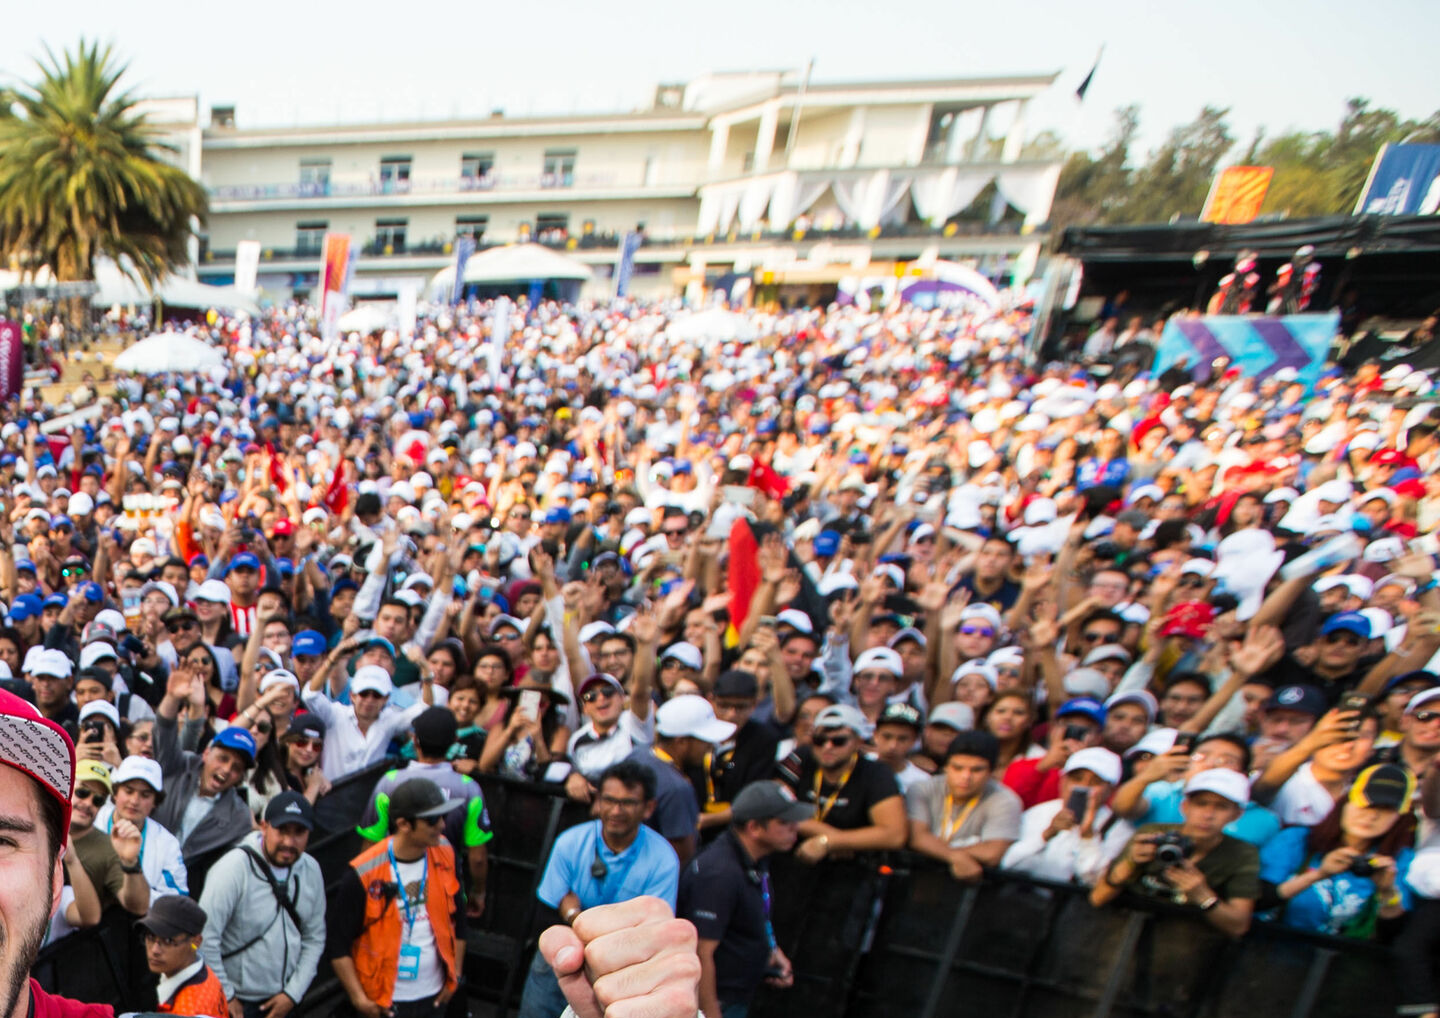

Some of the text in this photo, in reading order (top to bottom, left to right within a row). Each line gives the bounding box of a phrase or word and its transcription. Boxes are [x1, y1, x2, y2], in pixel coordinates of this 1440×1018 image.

[9, 723, 33, 744] e-tron
[33, 745, 57, 767] e-tron
[14, 743, 38, 763] e-tron
[37, 765, 60, 788] e-tron
[41, 737, 64, 758] e-tron
